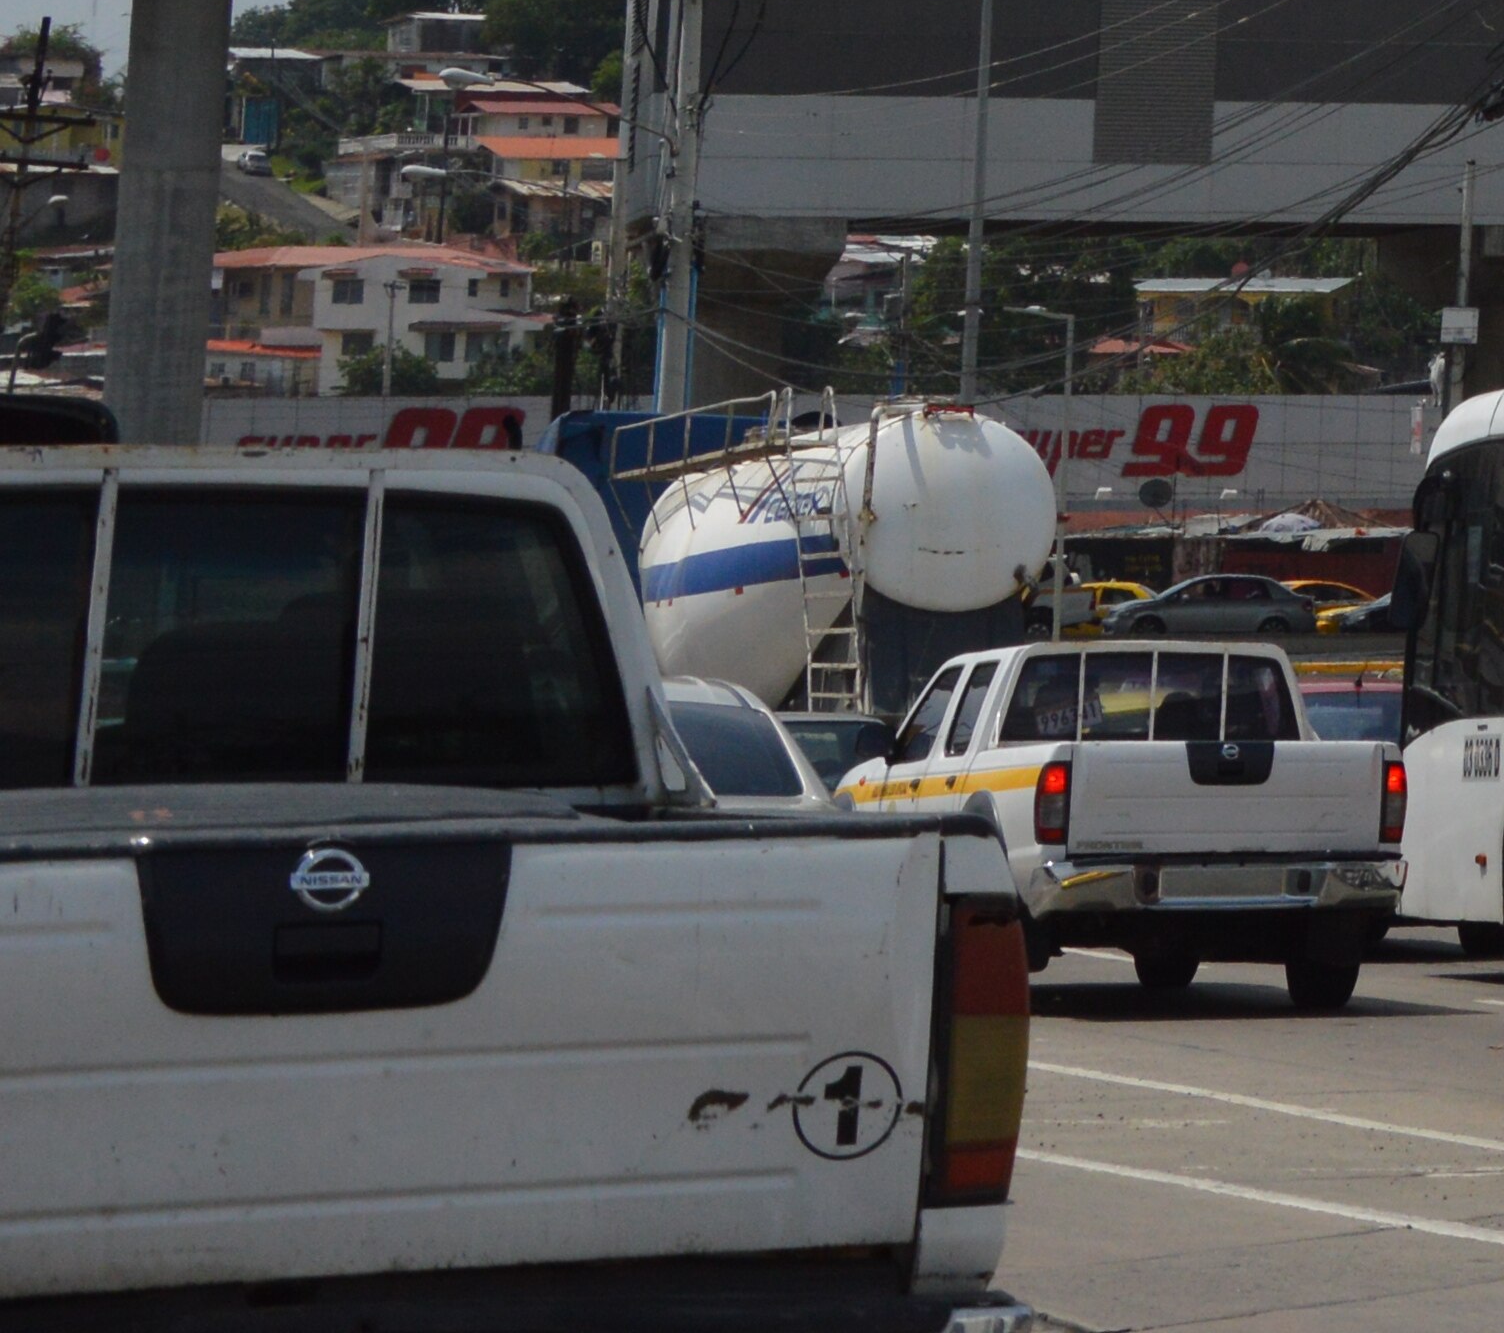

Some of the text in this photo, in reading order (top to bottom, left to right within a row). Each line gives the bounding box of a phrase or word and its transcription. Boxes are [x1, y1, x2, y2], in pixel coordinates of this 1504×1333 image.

[1016, 404, 1259, 479] uper 99
[300, 875, 362, 887] NISSAN
[823, 1065, 864, 1147] 1
